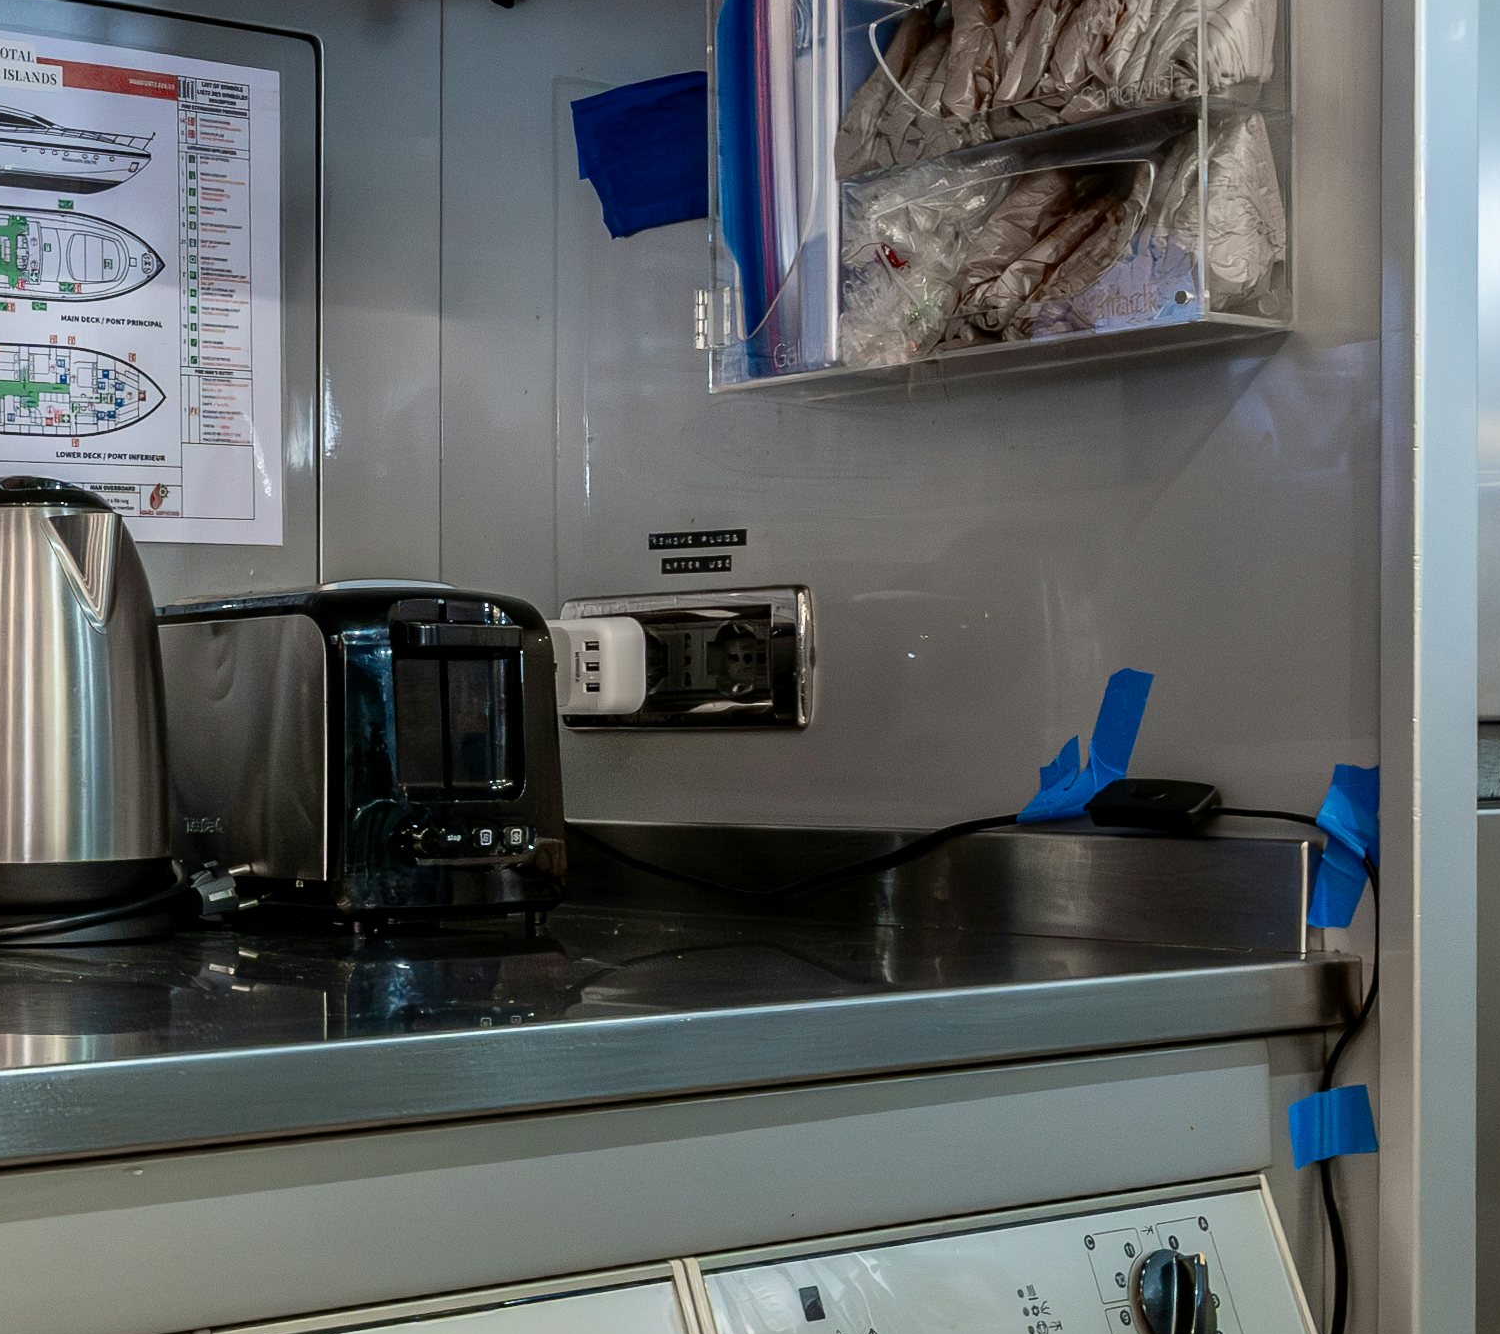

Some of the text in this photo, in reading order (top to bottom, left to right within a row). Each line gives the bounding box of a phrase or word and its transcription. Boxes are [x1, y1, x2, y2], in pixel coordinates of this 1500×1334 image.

[2, 68, 58, 86] ISLANDS
[61, 315, 80, 323] MAIN
[81, 316, 101, 324] DECK
[127, 319, 163, 328] PRINCIPAL
[56, 451, 81, 459] LOWER
[129, 453, 165, 462] INFERIEUR
[666, 561, 700, 570] AFTER
